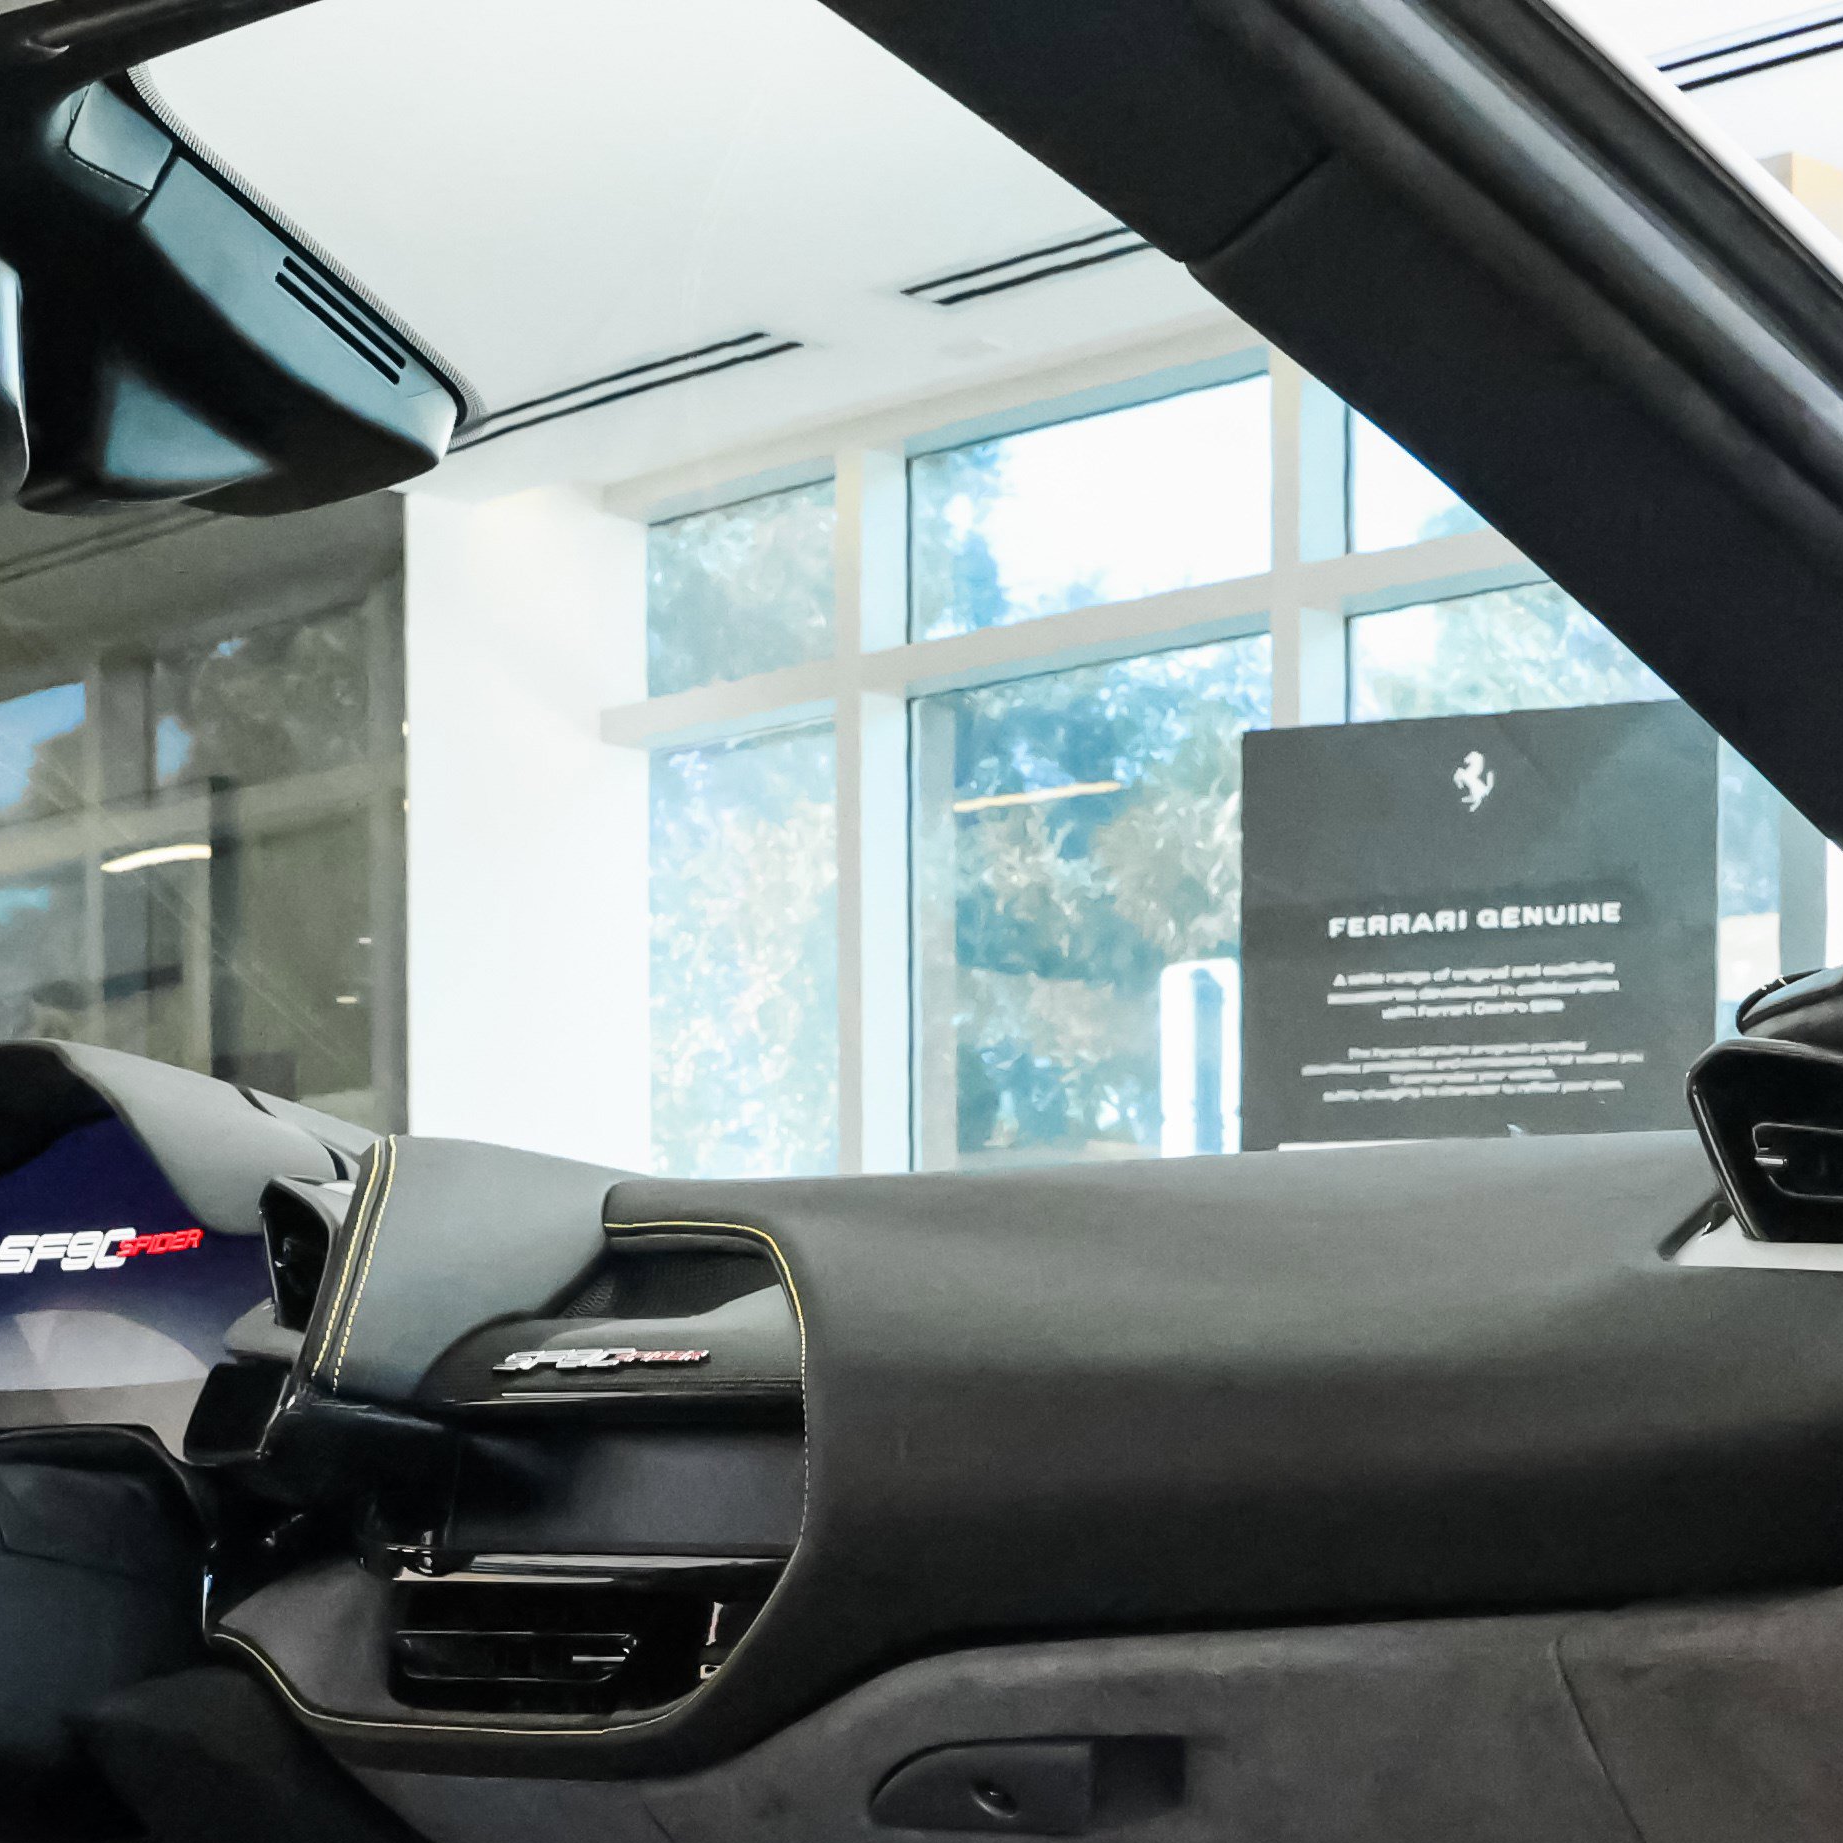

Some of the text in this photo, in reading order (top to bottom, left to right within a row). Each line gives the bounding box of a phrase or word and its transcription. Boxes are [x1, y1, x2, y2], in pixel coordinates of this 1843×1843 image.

[1327, 902, 1622, 938] FERRARI GENUINE
[116, 1228, 205, 1257] SPIDER
